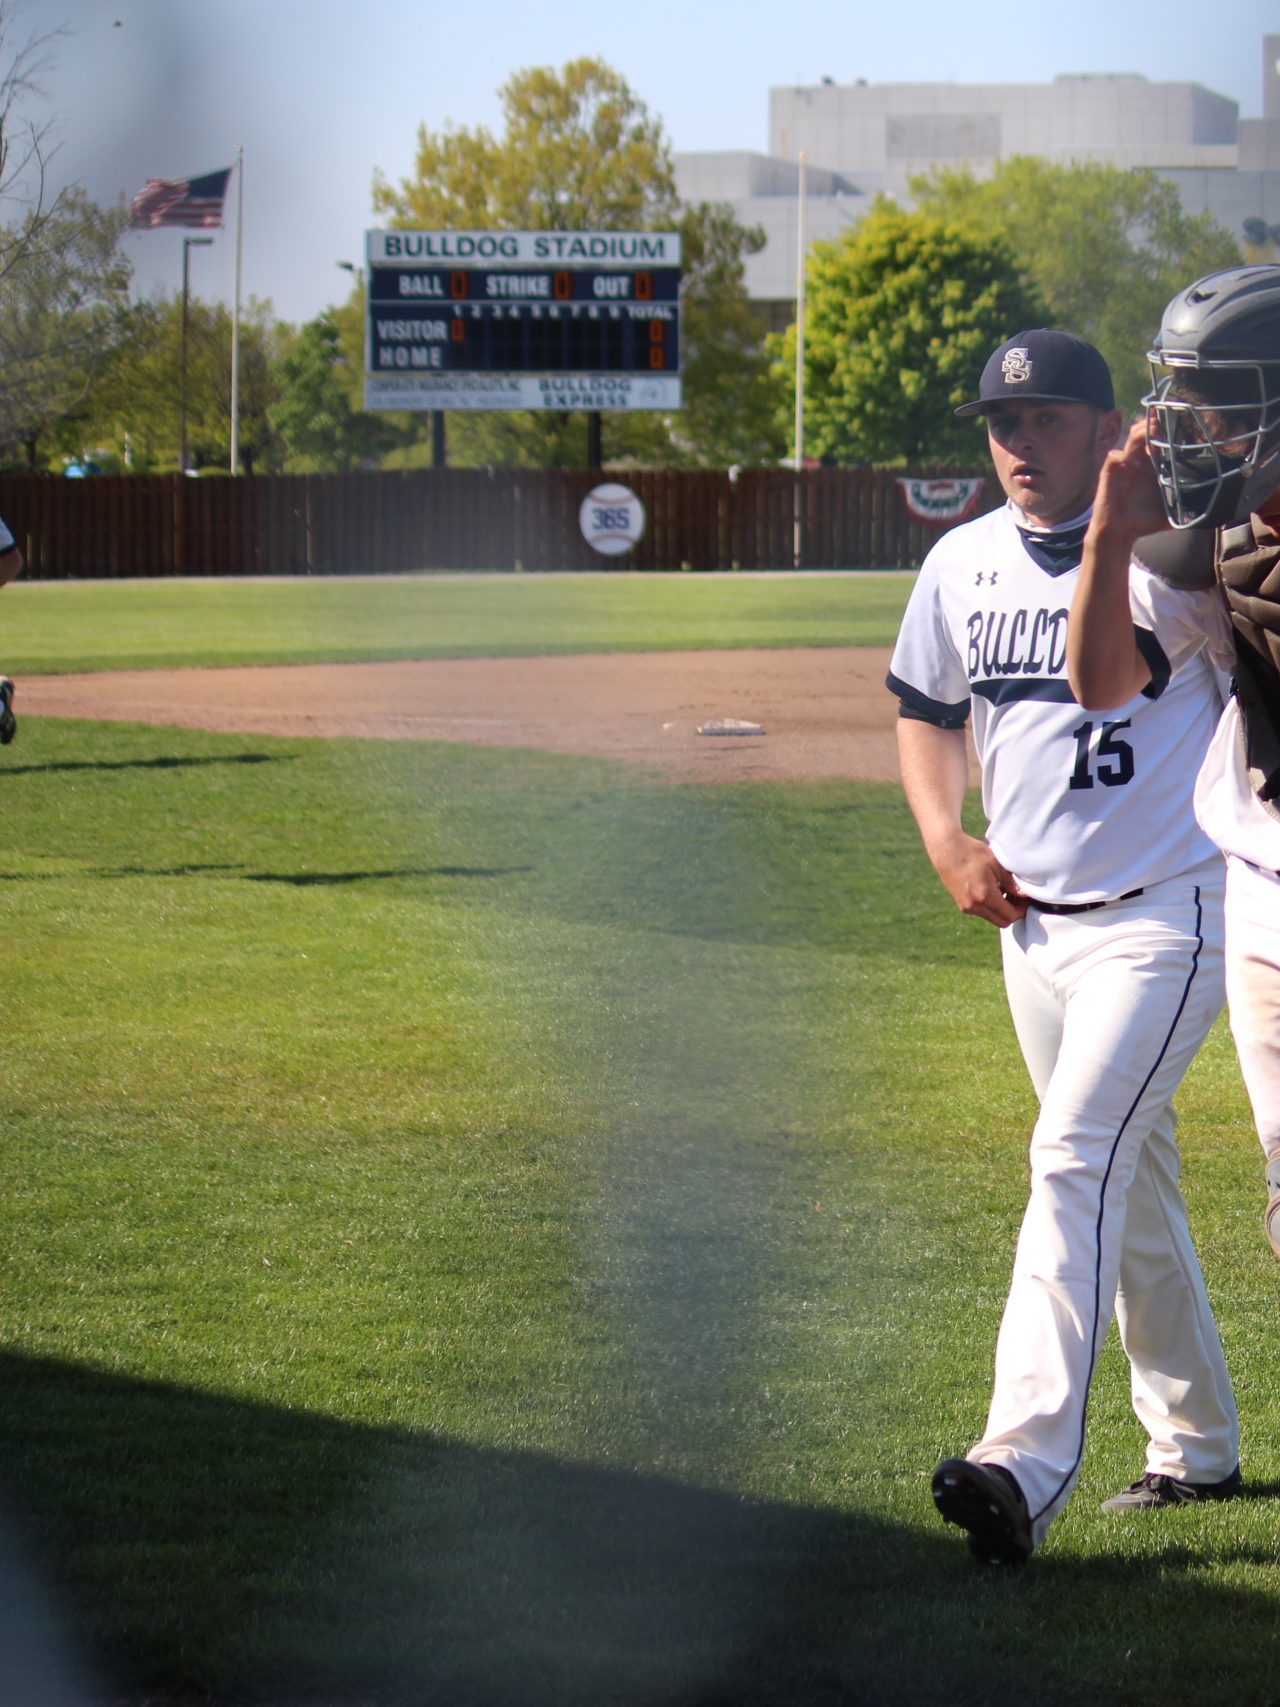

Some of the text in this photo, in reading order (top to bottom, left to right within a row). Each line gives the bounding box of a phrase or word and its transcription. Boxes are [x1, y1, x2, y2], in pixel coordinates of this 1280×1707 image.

[384, 236, 666, 258] BULLDOG STADIUM
[399, 275, 443, 295] BALL
[486, 275, 549, 296] STRIKE
[593, 275, 630, 296] OUT
[627, 305, 673, 320] TOTAL
[377, 320, 448, 341] VISITOR
[379, 347, 441, 367] HOME
[538, 379, 632, 393] BULLDOG
[543, 393, 628, 407] EXPRESS
[592, 508, 630, 530] 365
[1069, 717, 1135, 791] 15
